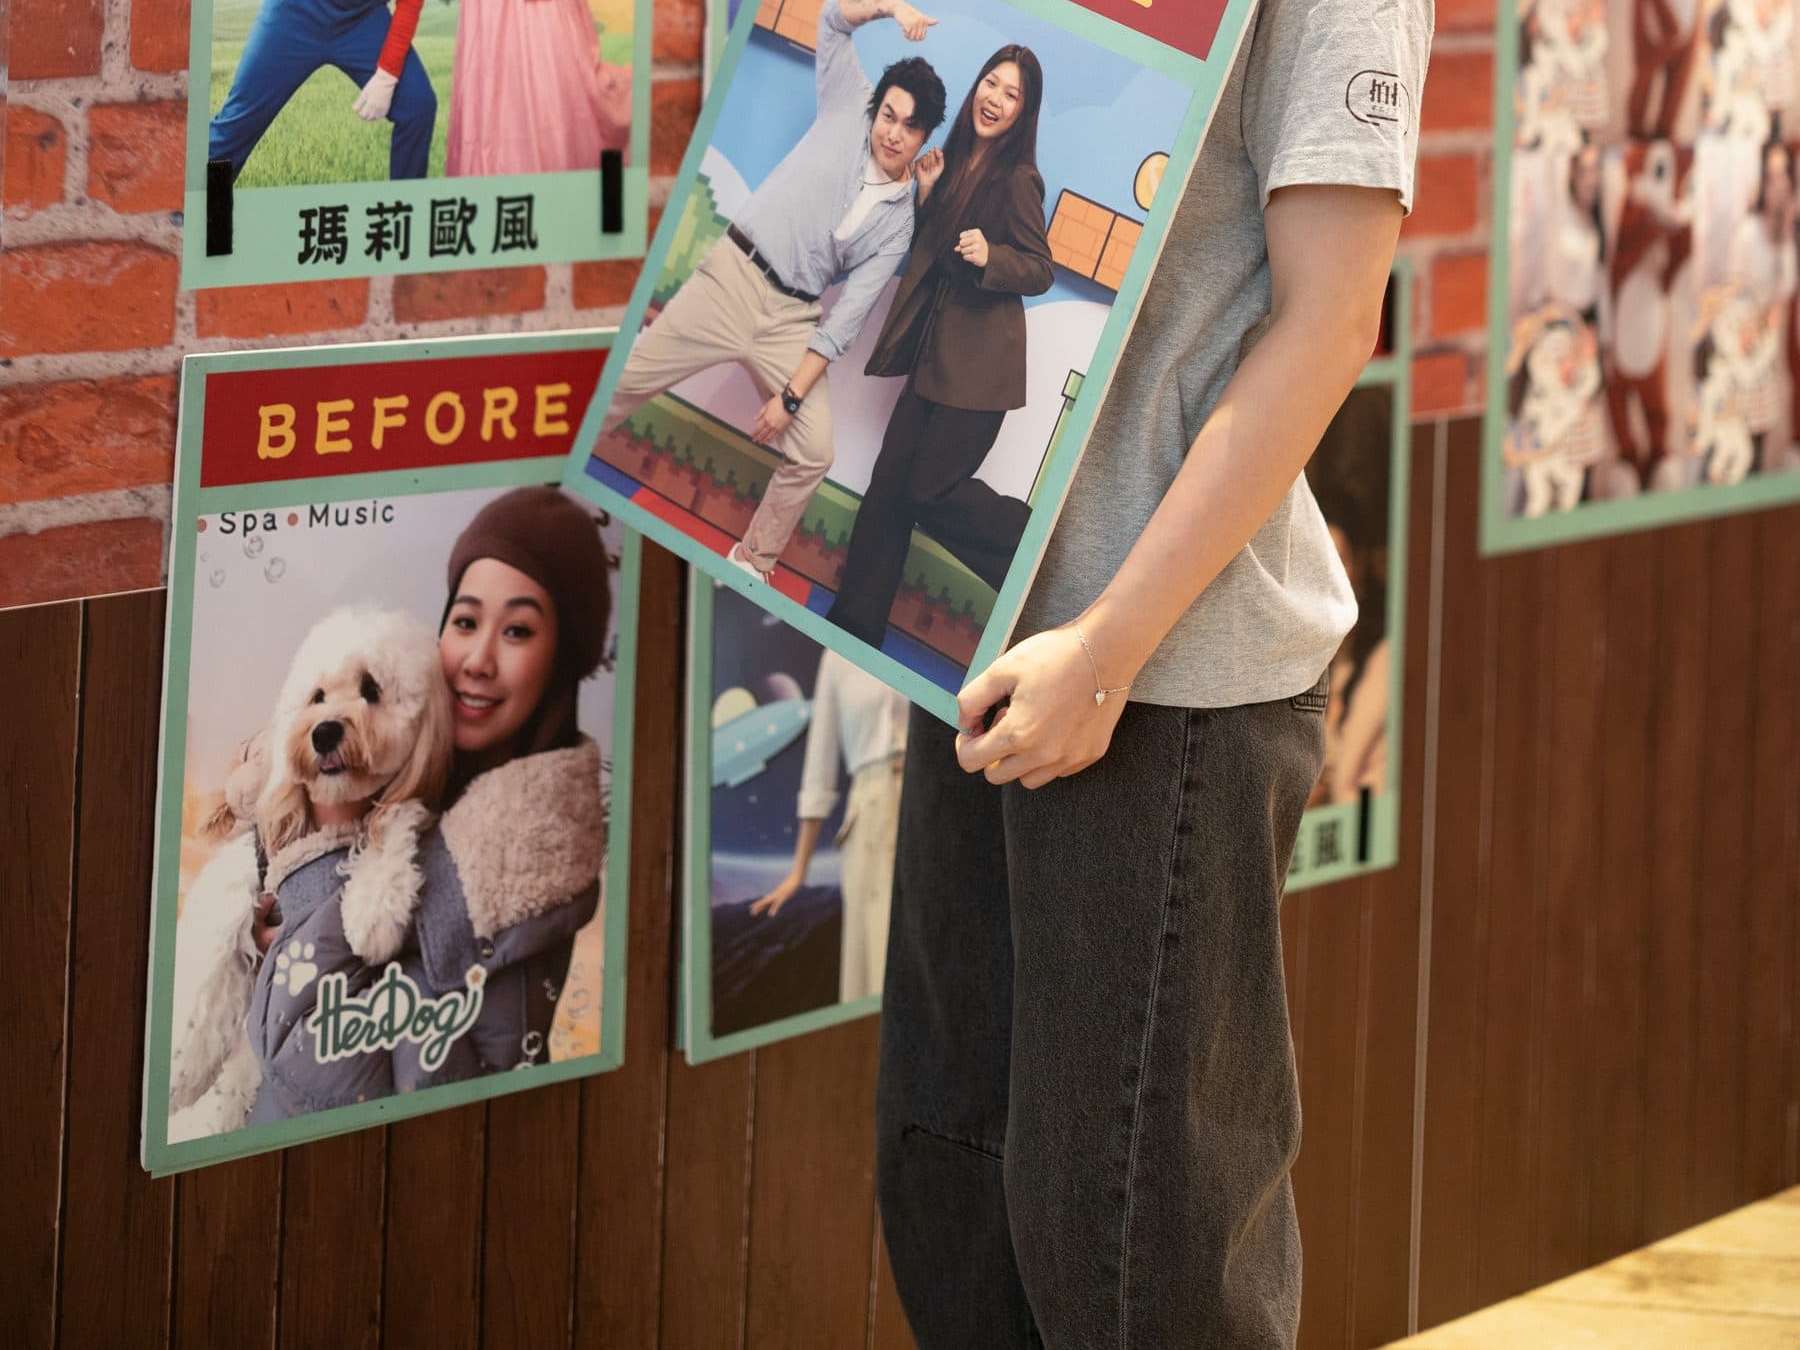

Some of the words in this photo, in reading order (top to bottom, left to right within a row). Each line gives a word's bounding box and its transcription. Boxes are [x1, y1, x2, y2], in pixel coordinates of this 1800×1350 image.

[297, 194, 538, 265] 瑪莉歐風
[257, 382, 572, 460] BEFORE
[219, 510, 279, 538] Spa
[308, 499, 395, 528] Music
[309, 961, 486, 1071] HerDog
